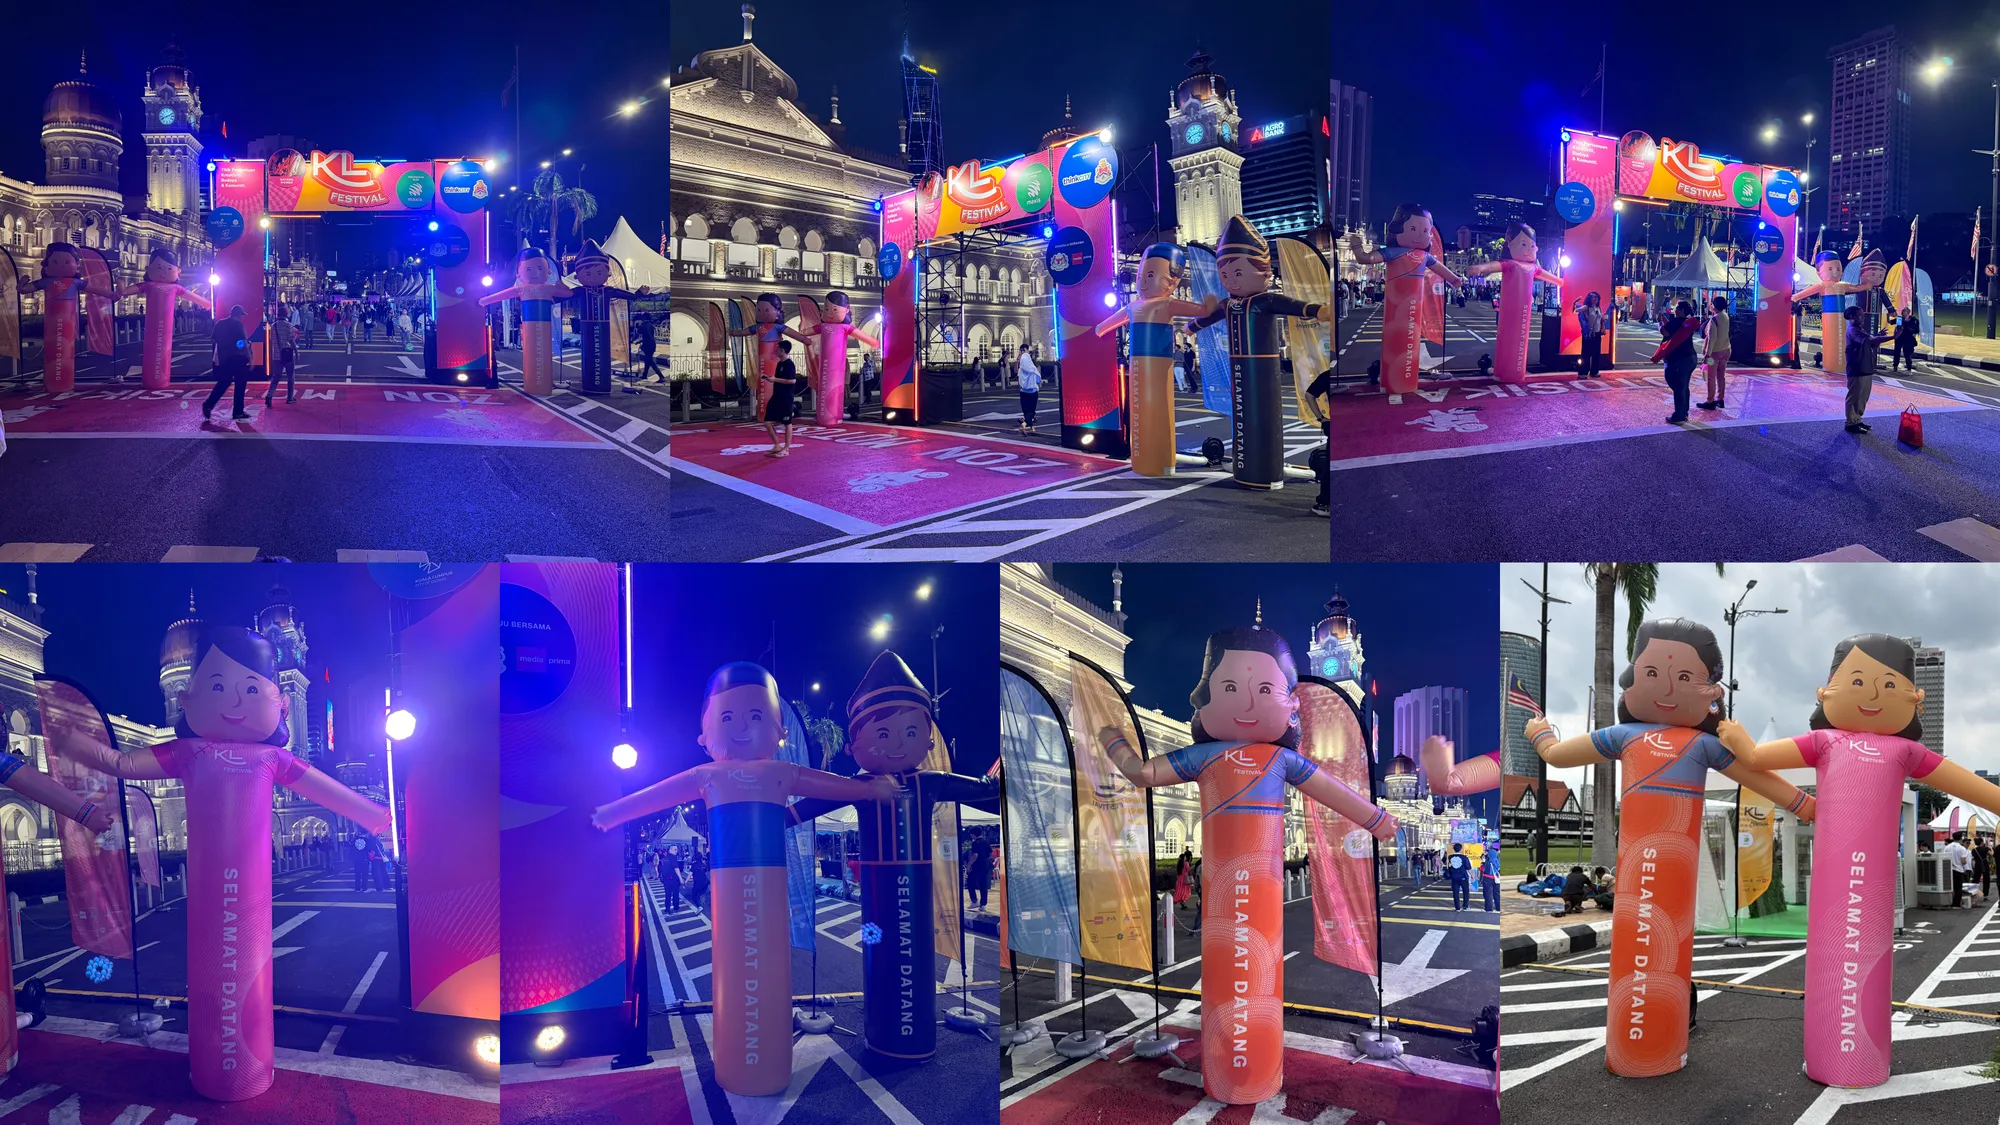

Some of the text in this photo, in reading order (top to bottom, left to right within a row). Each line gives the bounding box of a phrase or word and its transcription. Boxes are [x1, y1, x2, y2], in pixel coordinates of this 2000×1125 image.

[1265, 122, 1283, 132] AGRO
[1265, 129, 1284, 138] BANK
[1662, 140, 1715, 181] KL
[313, 153, 374, 187] KL
[948, 162, 996, 199] KL
[331, 192, 386, 204] FESTIVAL
[1678, 184, 1724, 198] FESTIVAL
[962, 203, 1007, 220] FESTIVAL
[1520, 304, 1528, 339] SELAMAT
[1405, 299, 1416, 379] SELAMAT DATANG
[384, 390, 504, 405] ZON
[1234, 364, 1245, 469] SELAMAT DATANG
[511, 621, 551, 631] BERSAMA
[548, 657, 571, 665] prima
[1643, 732, 1673, 750] KL
[1849, 740, 1881, 756] KL
[214, 749, 247, 764] KL
[1224, 749, 1257, 767] KL
[1650, 750, 1677, 758] FESTIVAL
[727, 769, 757, 782] KL
[1744, 807, 1766, 820] KL
[1629, 847, 1657, 1040] SELAMAT DATANG
[1840, 851, 1866, 1053] SELAMAT DATANG
[897, 875, 913, 1036] SELAMAT DATANG
[221, 868, 238, 1070] SELAMAT DATANG
[743, 874, 759, 1065] SELAMAT DATANG
[1233, 869, 1249, 1068] SELAMAT DATANG
